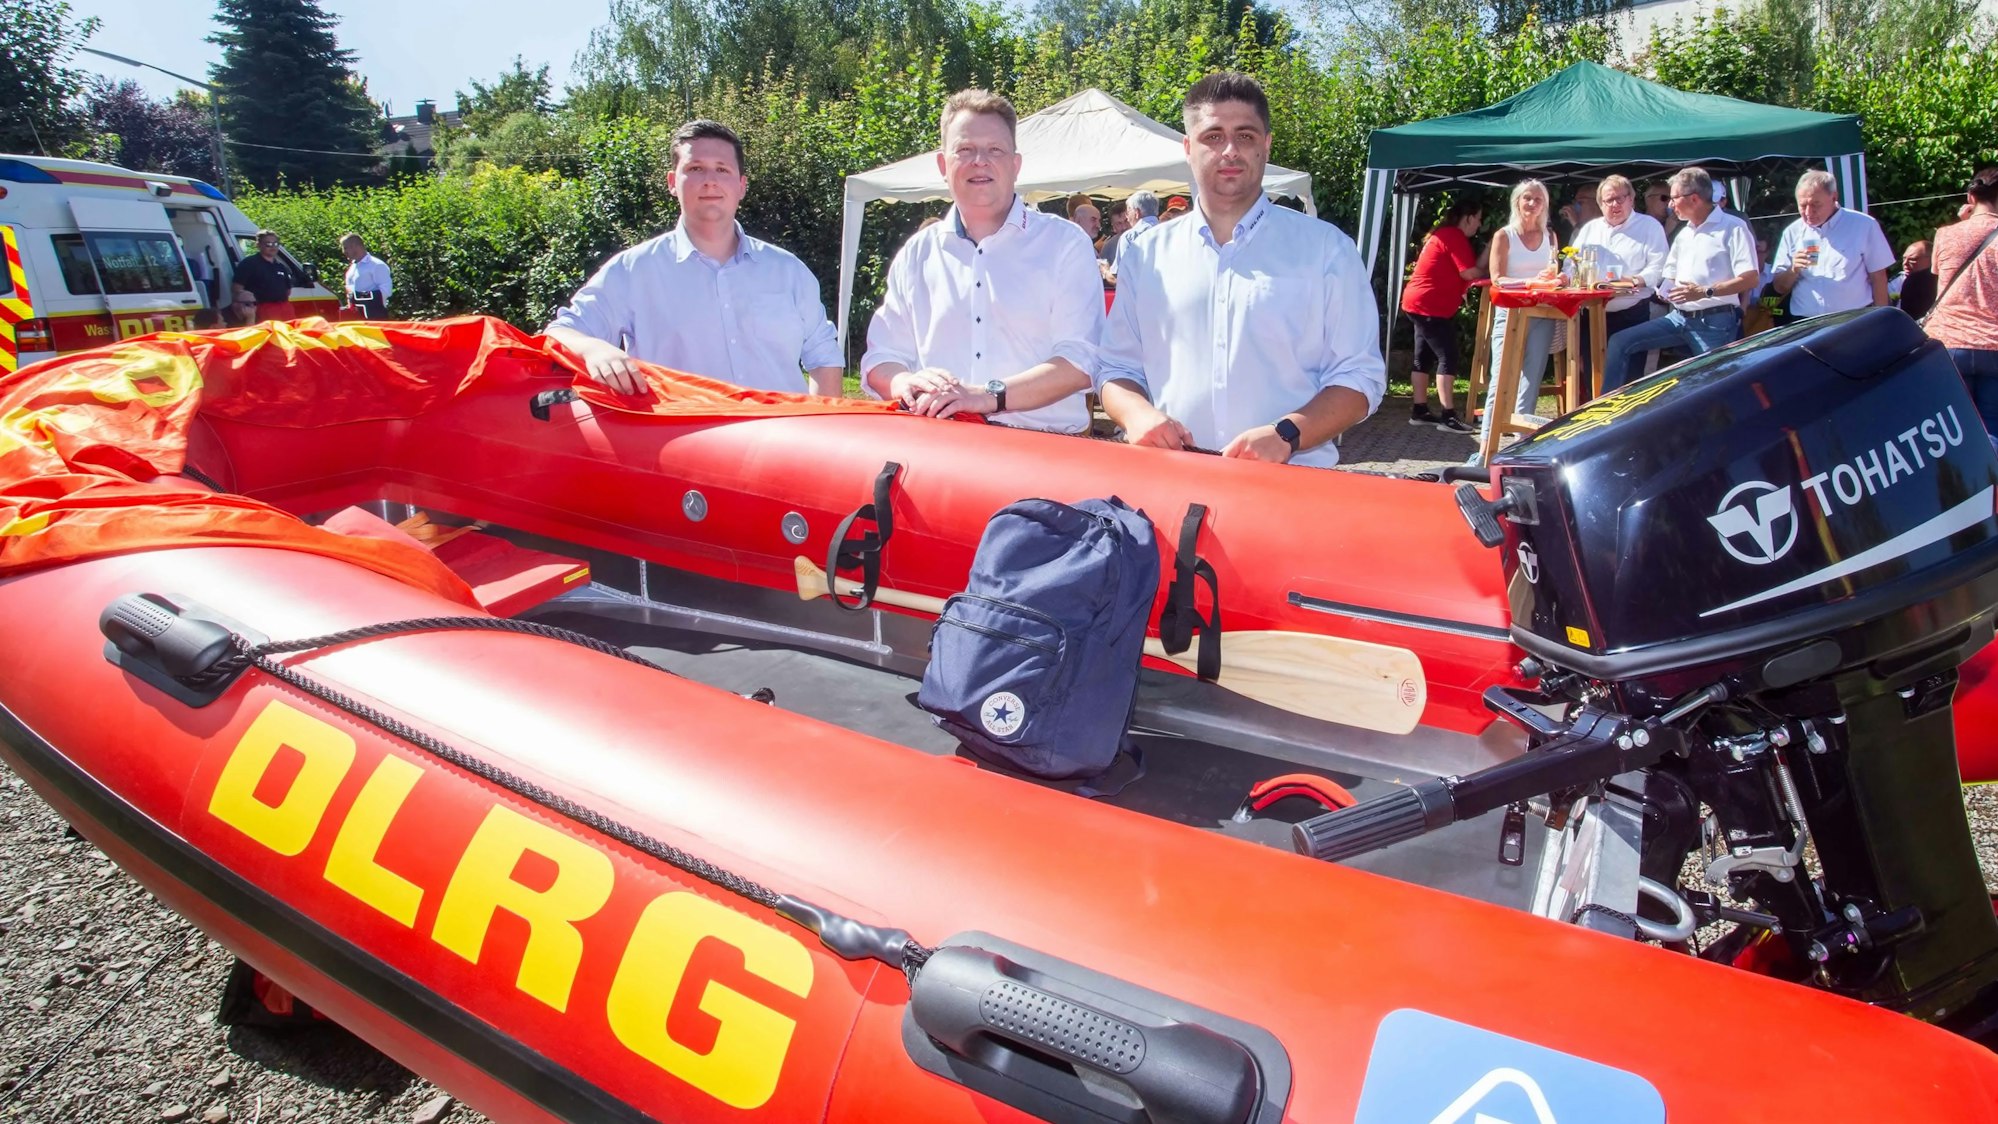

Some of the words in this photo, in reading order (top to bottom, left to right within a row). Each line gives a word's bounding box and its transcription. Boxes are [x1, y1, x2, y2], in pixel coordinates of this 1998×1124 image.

[102, 255, 137, 269] Notfall
[1801, 404, 1965, 517] TOHATSU
[989, 695, 1021, 711] CONVERSE
[207, 698, 815, 1110] DLRG
